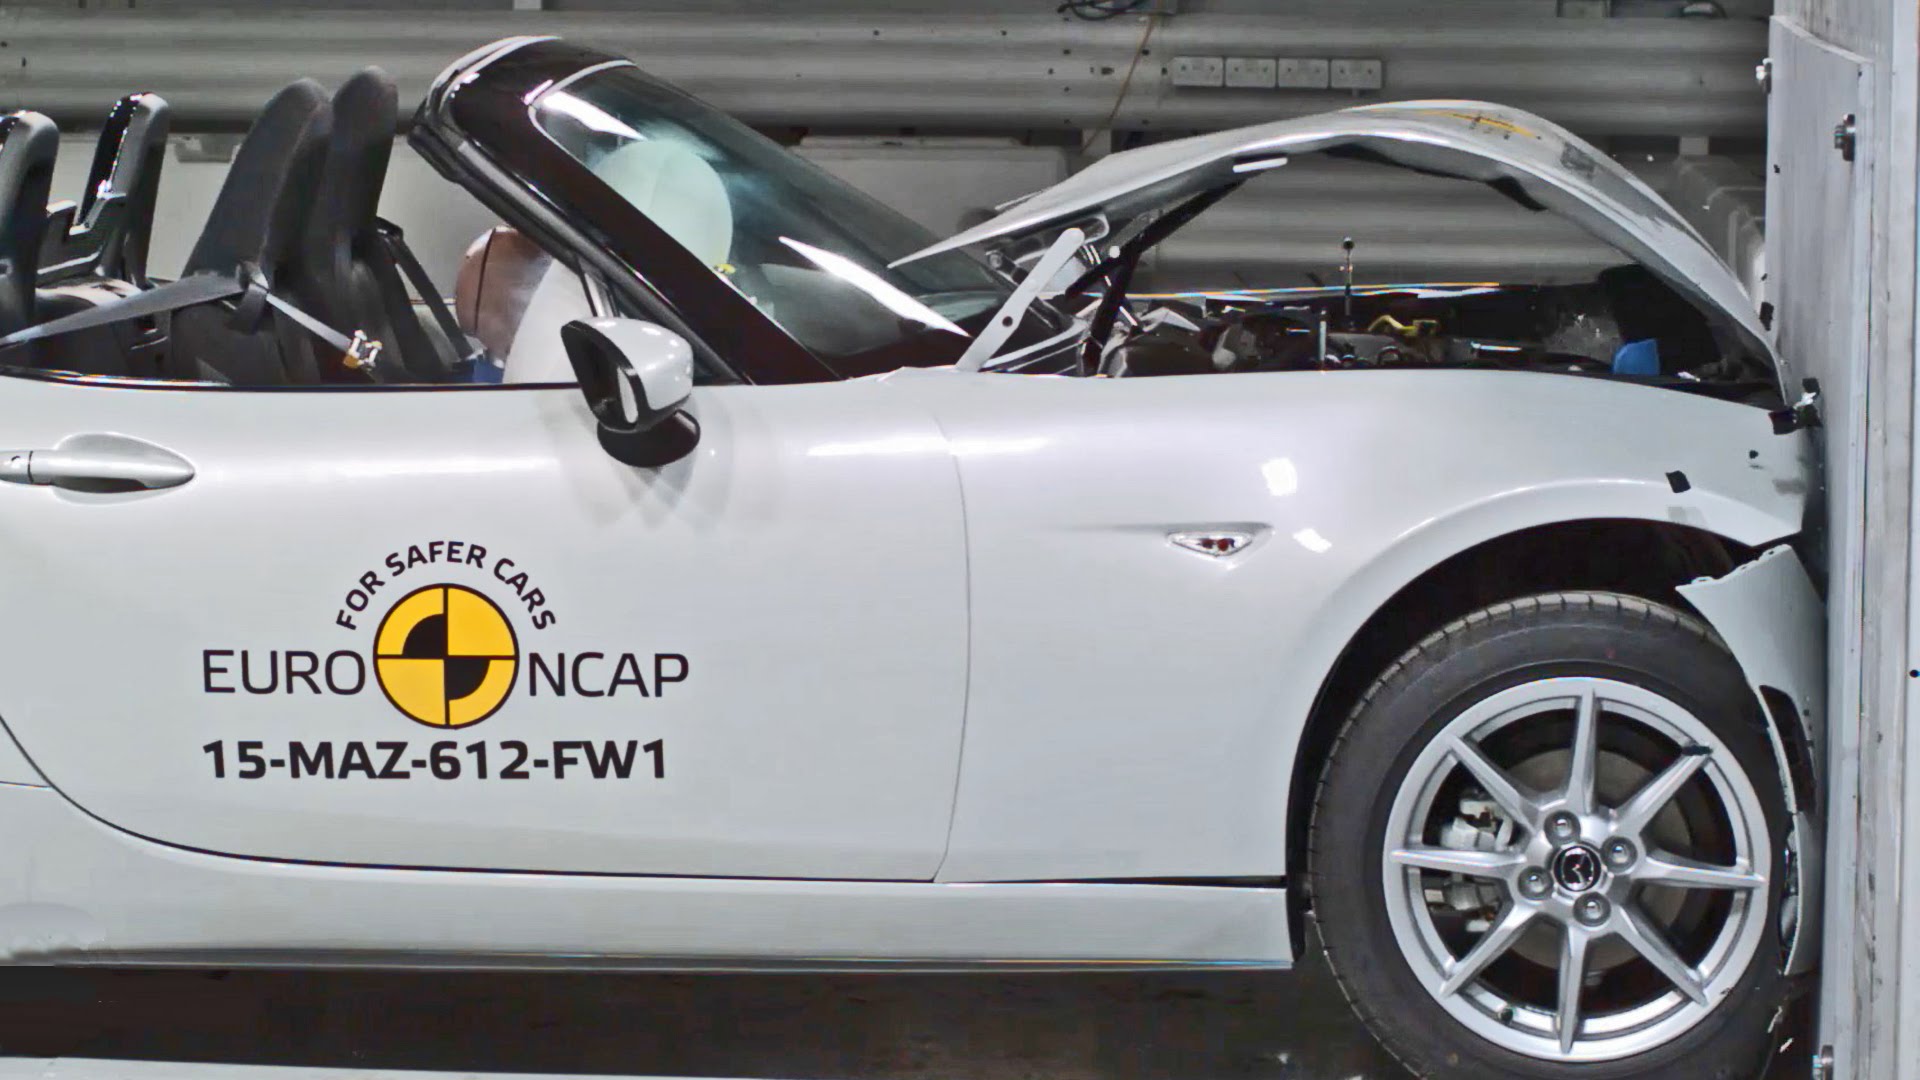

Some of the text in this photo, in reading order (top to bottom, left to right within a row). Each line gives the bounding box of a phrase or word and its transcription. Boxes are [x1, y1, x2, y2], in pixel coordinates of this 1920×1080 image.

[335, 540, 556, 631] FOR SAFER CARS
[202, 649, 689, 698] EURO NCAP
[202, 739, 665, 780] 15-MAZ-612-FW1
